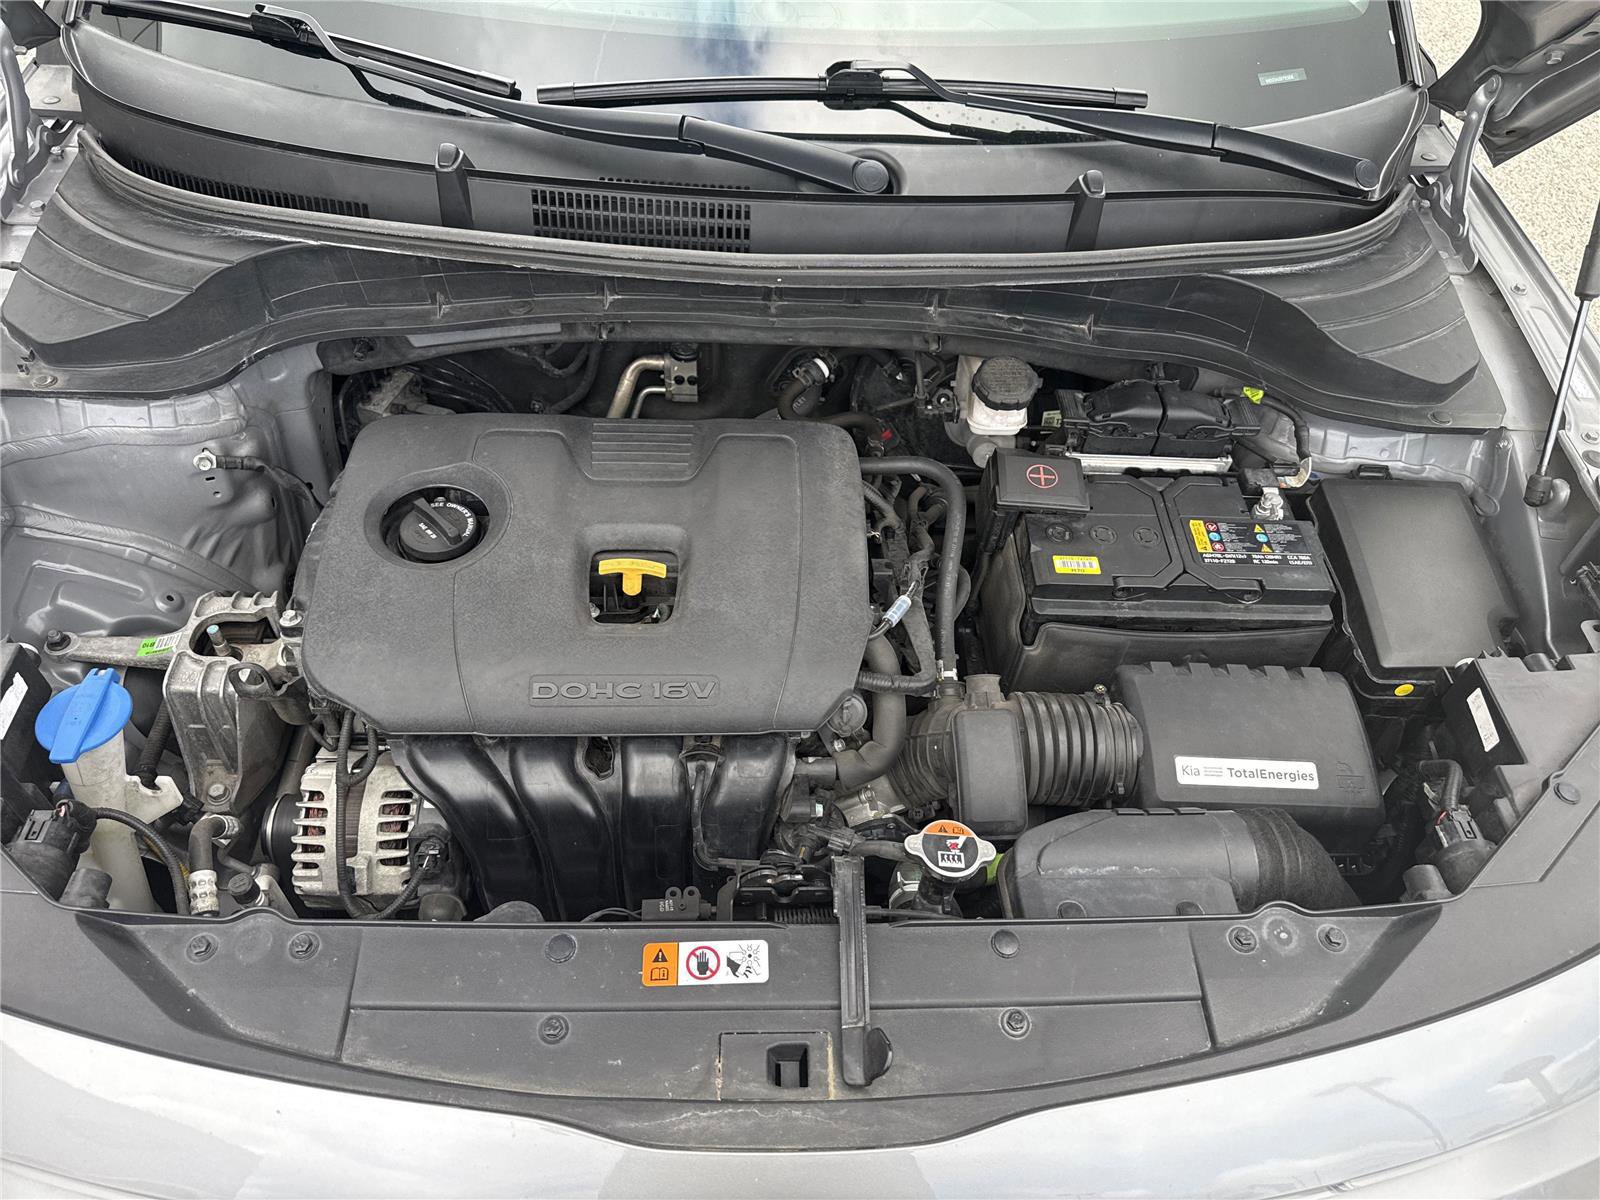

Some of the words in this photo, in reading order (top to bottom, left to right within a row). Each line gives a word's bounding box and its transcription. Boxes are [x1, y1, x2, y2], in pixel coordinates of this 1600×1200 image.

[462, 517, 473, 537] MANUAL
[532, 682, 642, 700] DOHC
[652, 681, 717, 700] 16V
[1181, 764, 1200, 777] Kia
[1226, 767, 1315, 783] TotalEnergies
